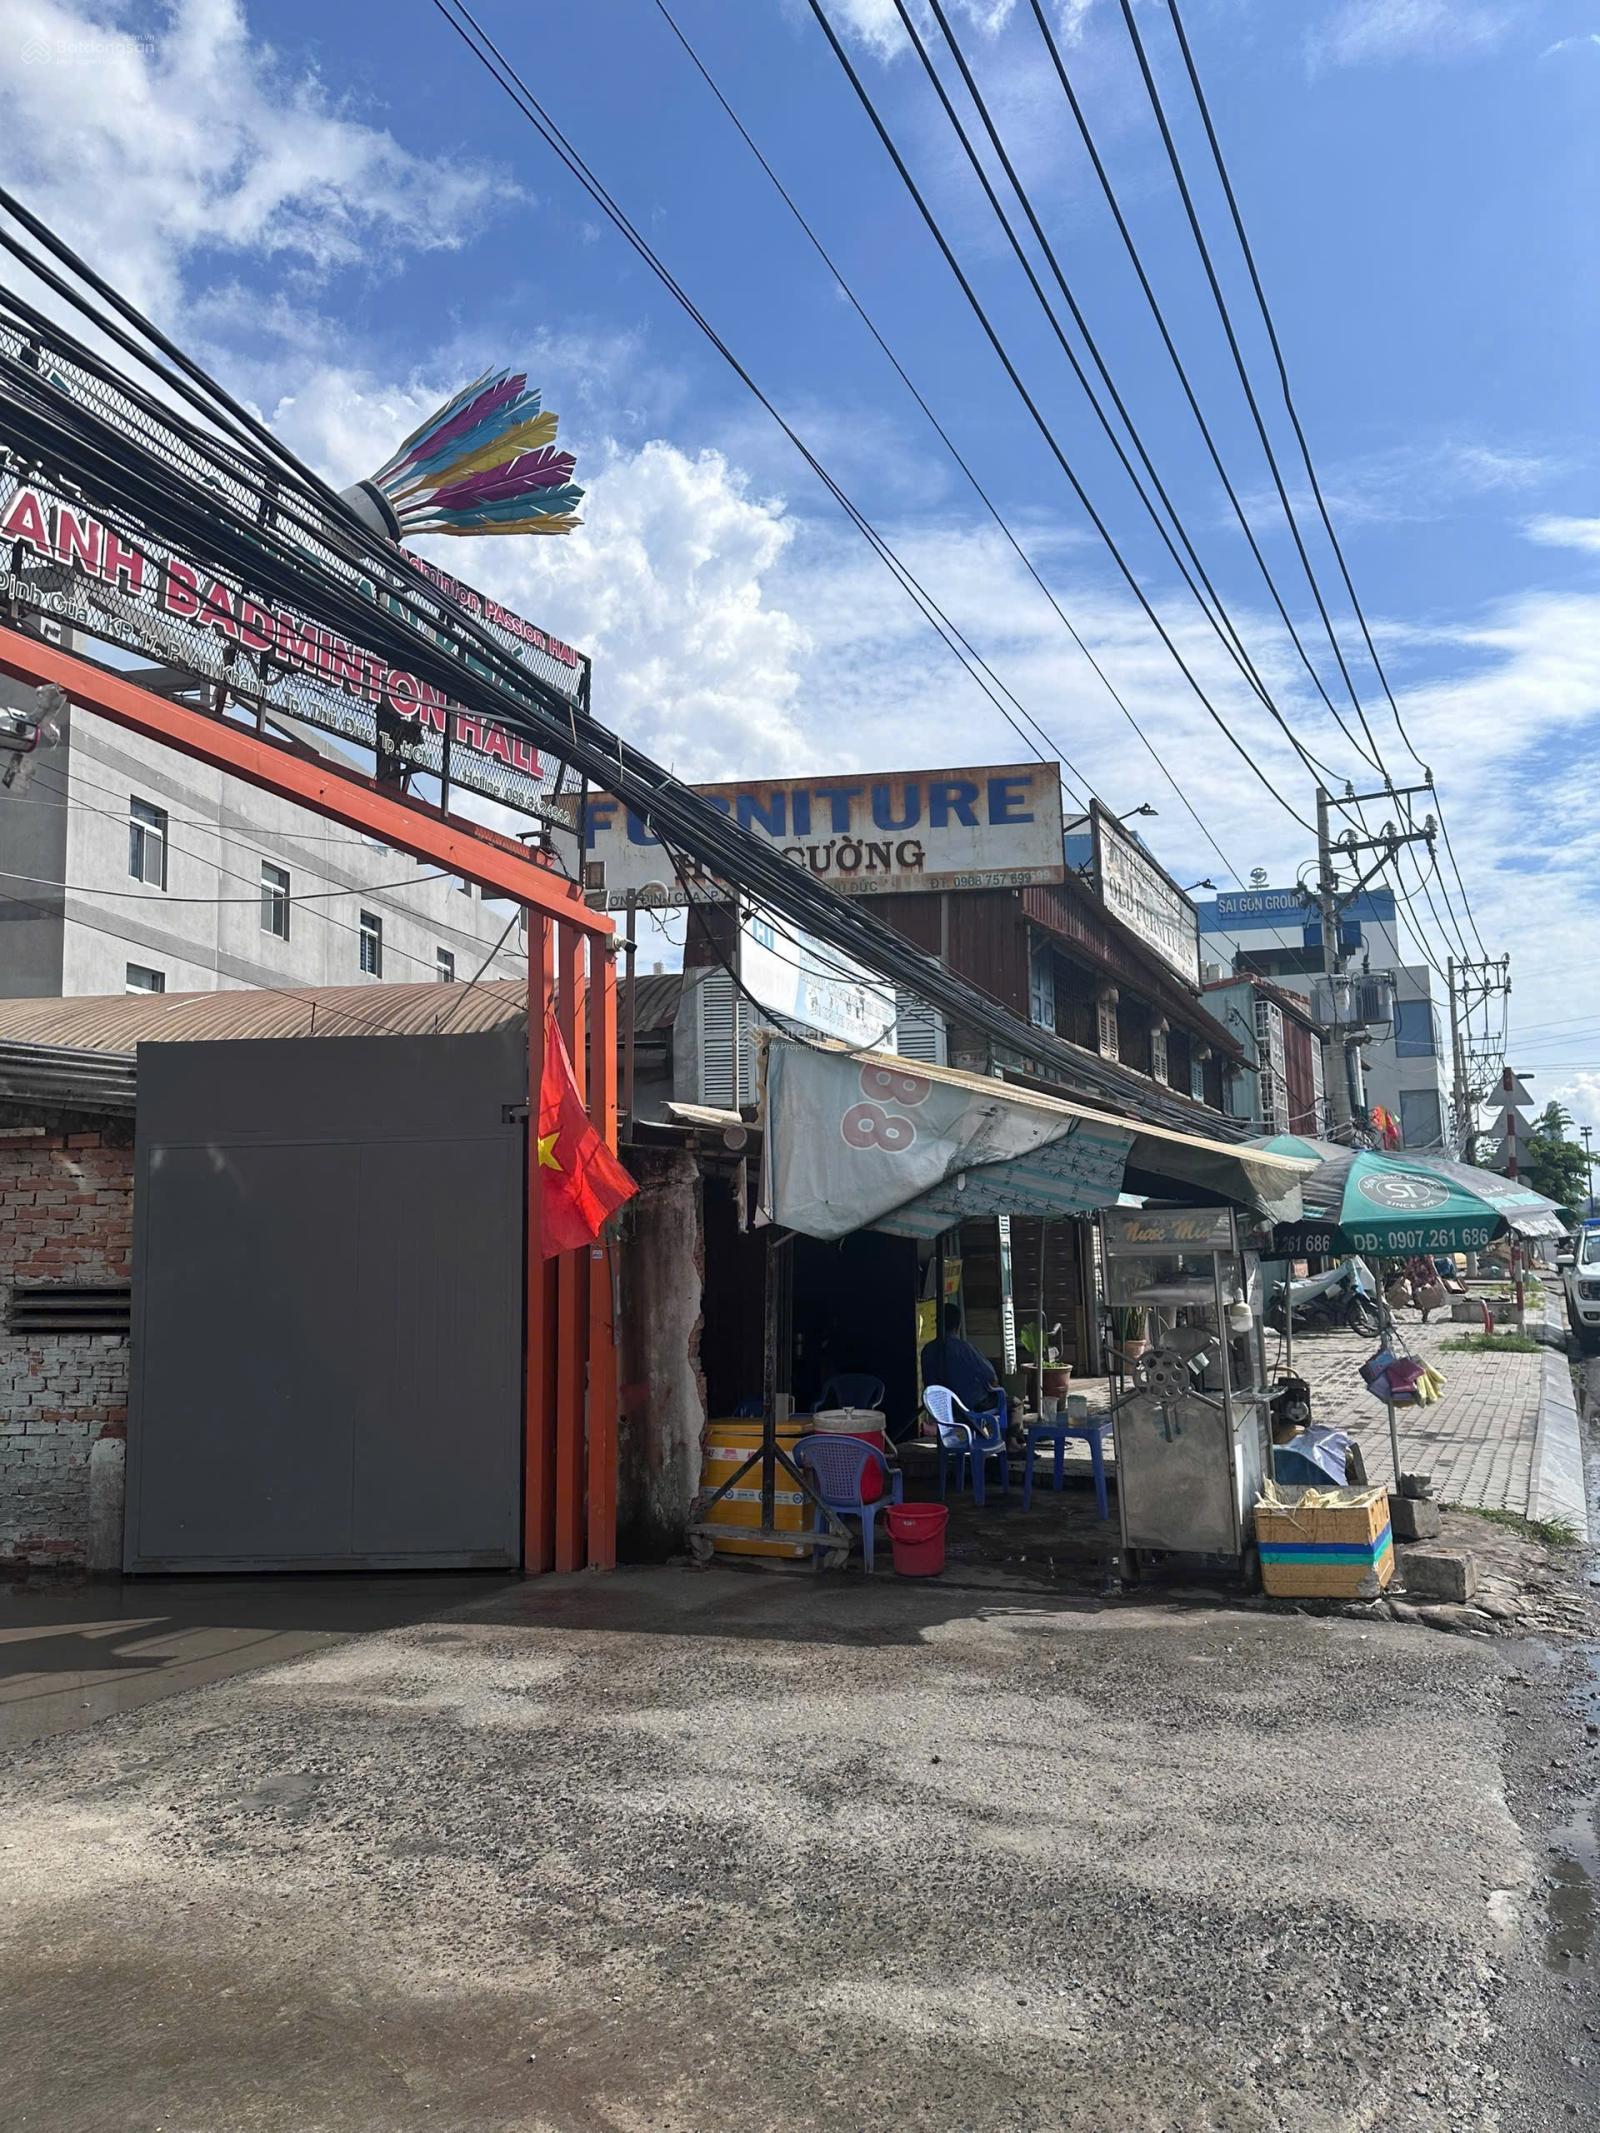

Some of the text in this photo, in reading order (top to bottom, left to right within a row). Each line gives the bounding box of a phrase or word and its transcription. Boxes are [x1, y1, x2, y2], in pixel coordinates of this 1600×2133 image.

[164, 554, 447, 733] BADMINTON
[456, 702, 544, 780] HALL
[578, 775, 1035, 850] FUNITURE
[1384, 1183, 1418, 1199] ST
[1306, 1234, 1331, 1252] 686
[1462, 1228, 1489, 1246] 686
